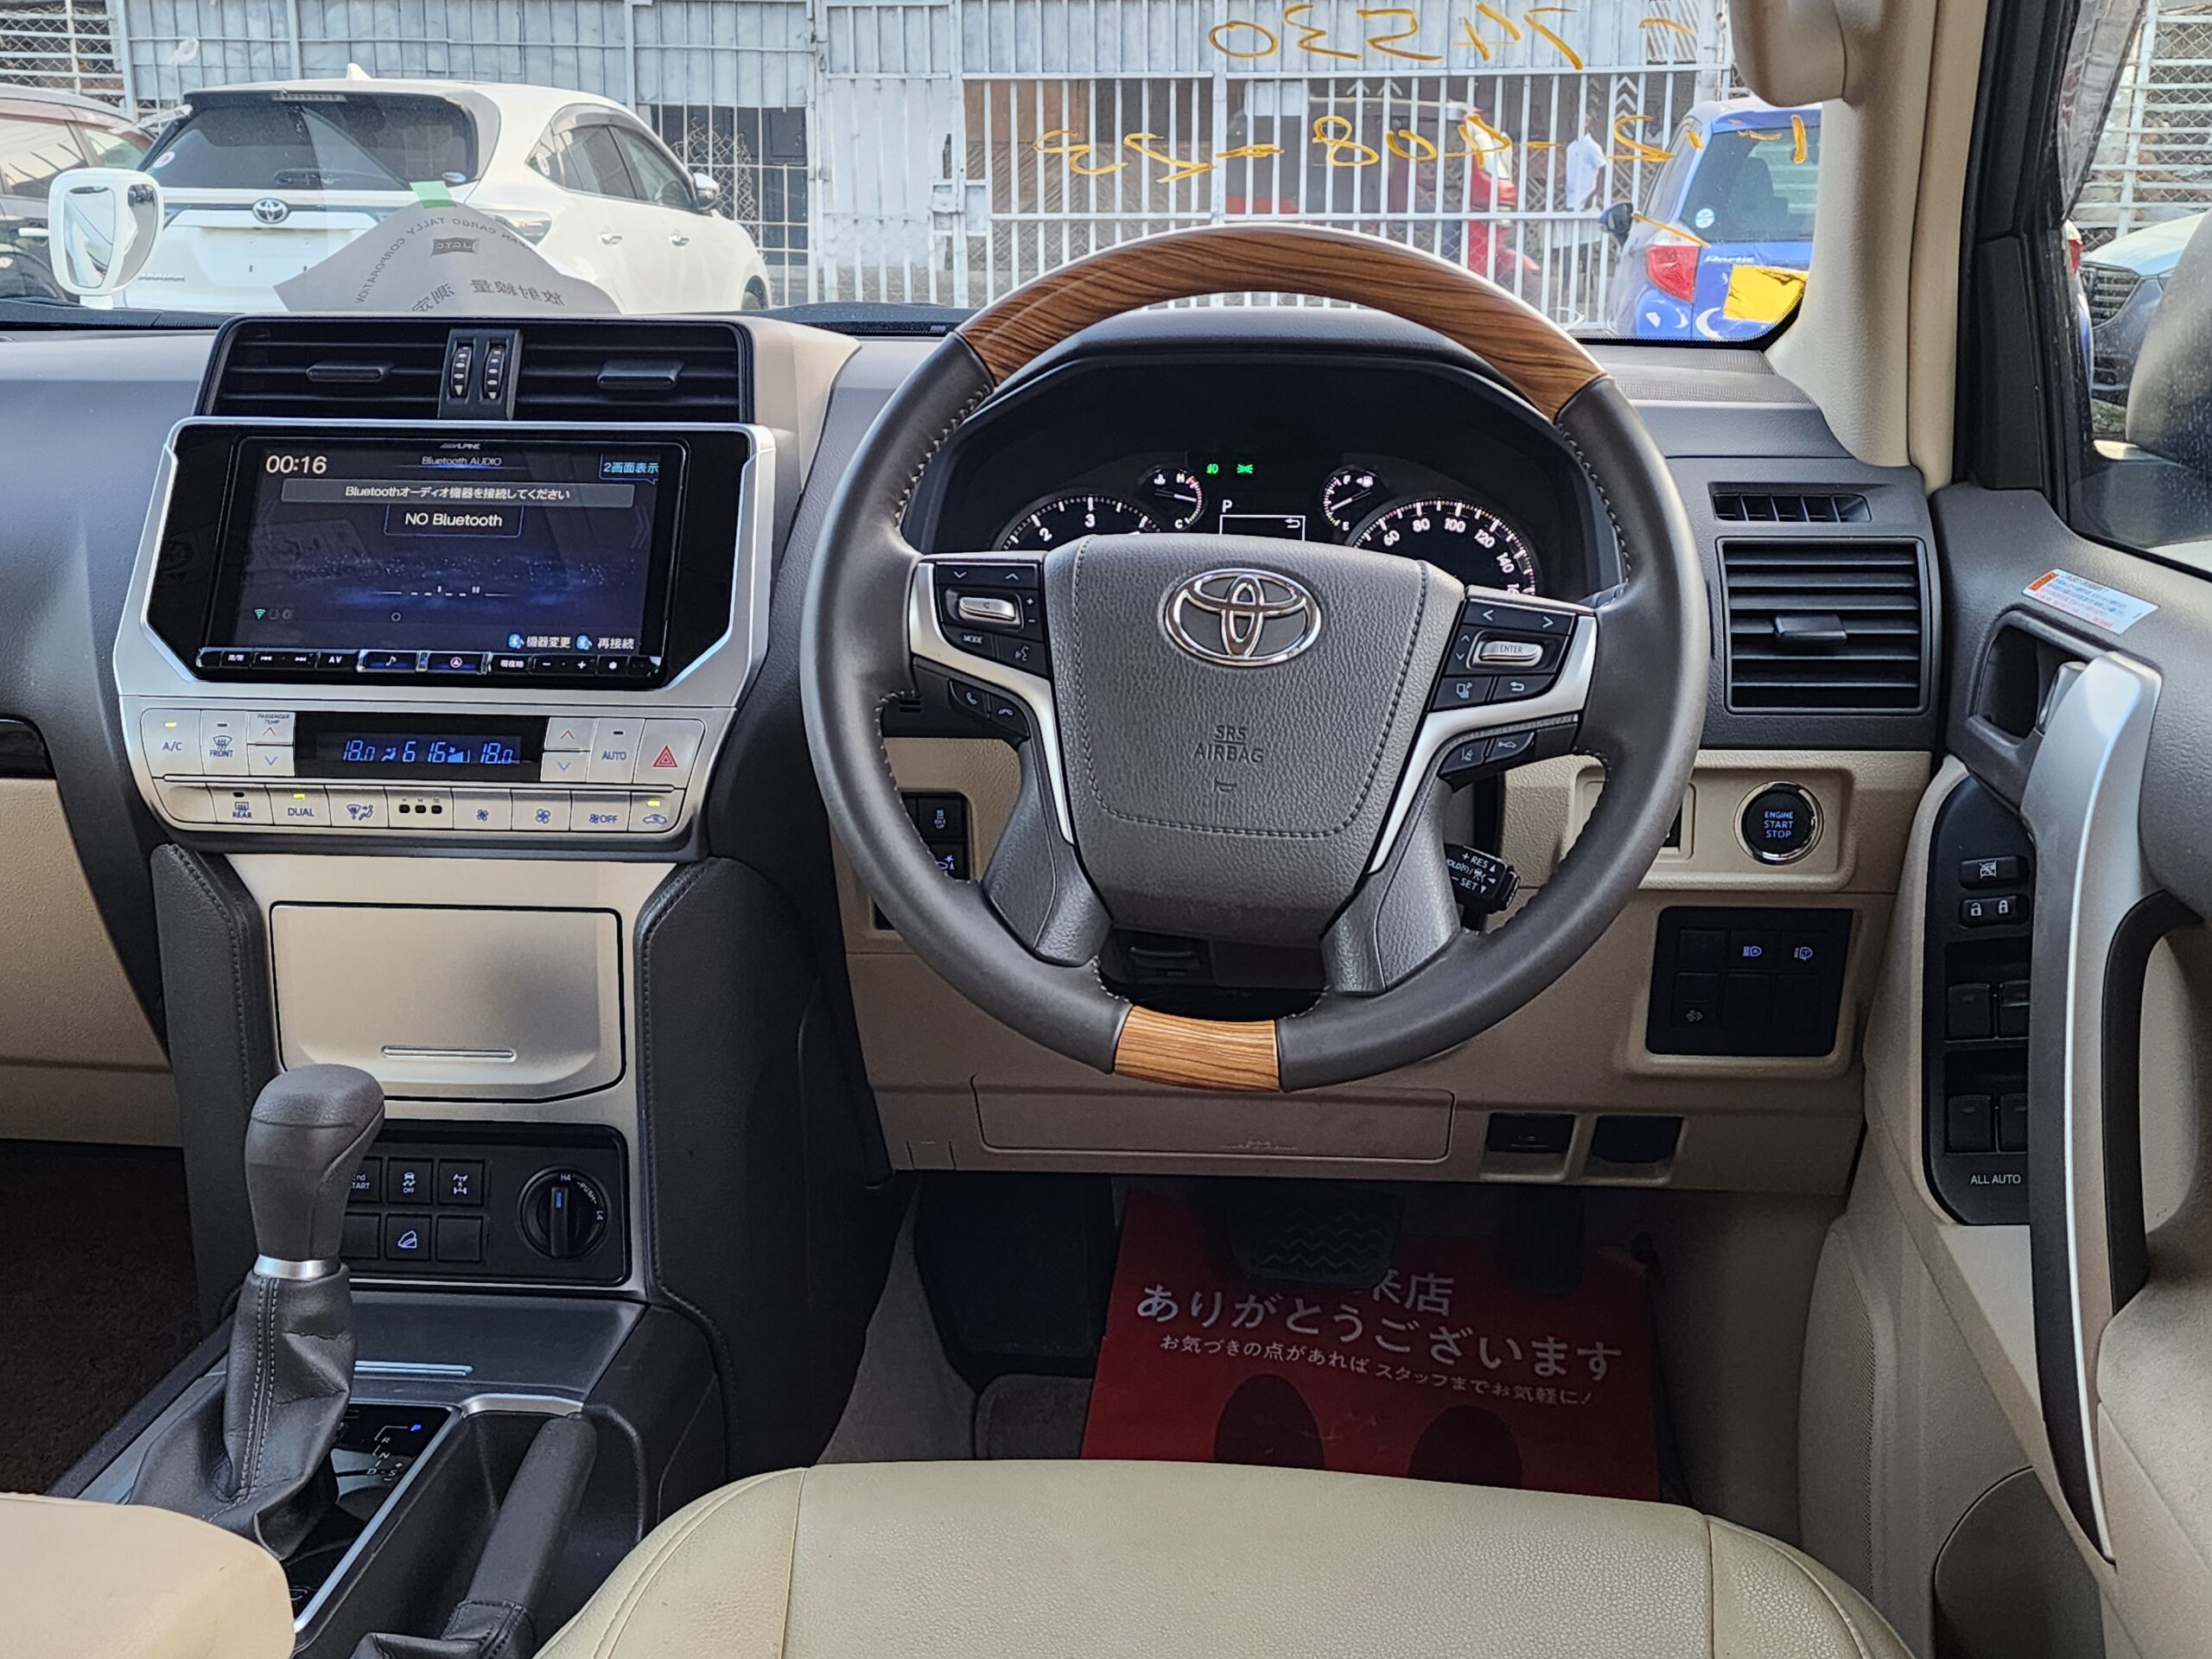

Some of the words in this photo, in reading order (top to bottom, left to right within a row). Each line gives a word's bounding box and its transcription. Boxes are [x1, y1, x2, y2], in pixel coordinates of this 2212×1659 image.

[265, 455, 327, 474] 00:16
[422, 455, 467, 466] Bluetooth
[469, 456, 502, 467] AUDIO
[603, 461, 659, 474] 2画面表示
[1222, 499, 1233, 513] P
[404, 513, 429, 526] NO
[432, 512, 503, 527] Bluetooth
[1084, 513, 1096, 528] 3
[1412, 518, 1431, 532] 80
[1444, 518, 1467, 533] 100
[1039, 527, 1053, 542] 2
[1383, 530, 1401, 546] 60
[1473, 528, 1496, 549] 120
[1496, 551, 1515, 574] 140
[526, 636, 571, 649] 機器変更
[597, 637, 636, 650] 再接続
[963, 634, 984, 645] MODE
[1499, 644, 1523, 654] ENTER
[1213, 724, 1247, 741] SRS
[162, 741, 184, 752] A/C
[209, 749, 234, 759] FRONT
[601, 750, 628, 761] AUTO
[1193, 743, 1263, 764] AIRBAG
[232, 810, 253, 819] REAR
[287, 807, 315, 817] DUAL
[599, 814, 619, 823] OFF
[1764, 810, 1794, 819] ENGINE
[1764, 820, 1795, 829] START
[1765, 830, 1792, 838] STOP
[1470, 855, 1490, 868] RES
[1459, 877, 1478, 891] SET
[1970, 1174, 1990, 1185] ALL
[1991, 1173, 2022, 1185] AUTO
[1136, 1283, 1623, 1381] ありがとうございます
[1160, 1334, 1370, 1375] お気づきの点があれば
